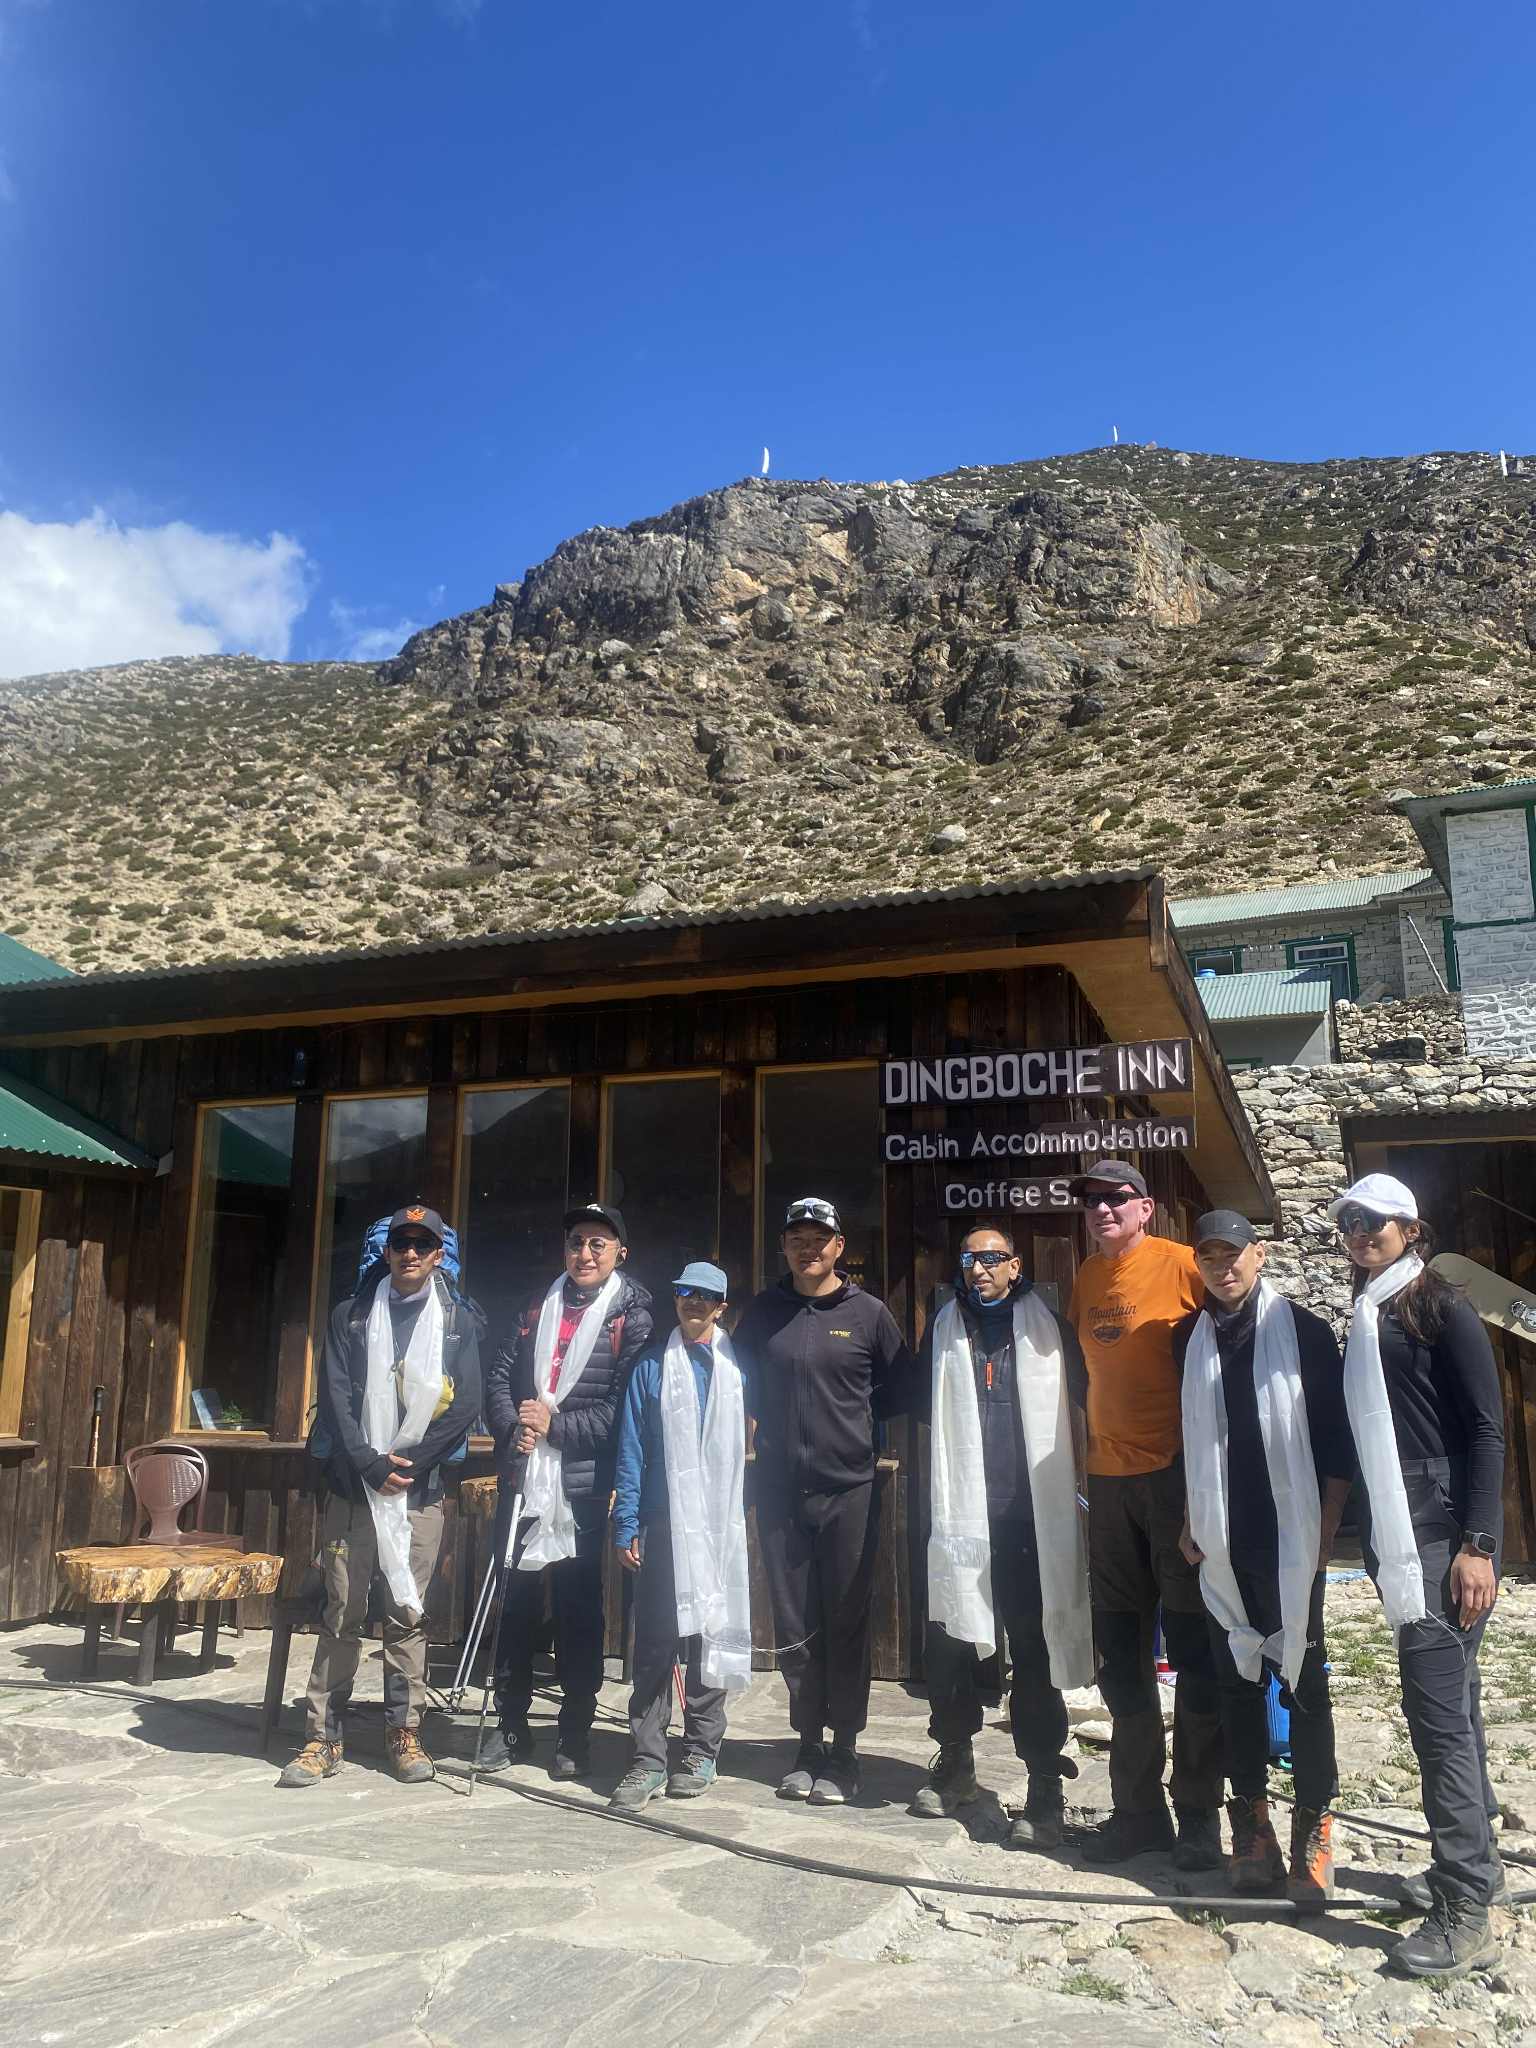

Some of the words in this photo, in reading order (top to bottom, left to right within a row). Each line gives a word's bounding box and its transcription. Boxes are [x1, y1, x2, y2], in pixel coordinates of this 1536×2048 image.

[885, 1049, 1103, 1104] DINGBOCHE
[1117, 1043, 1186, 1091] INN
[885, 1133, 959, 1161] Cabin
[970, 1120, 1189, 1158] Accommodation
[944, 1179, 1042, 1209] Coffee
